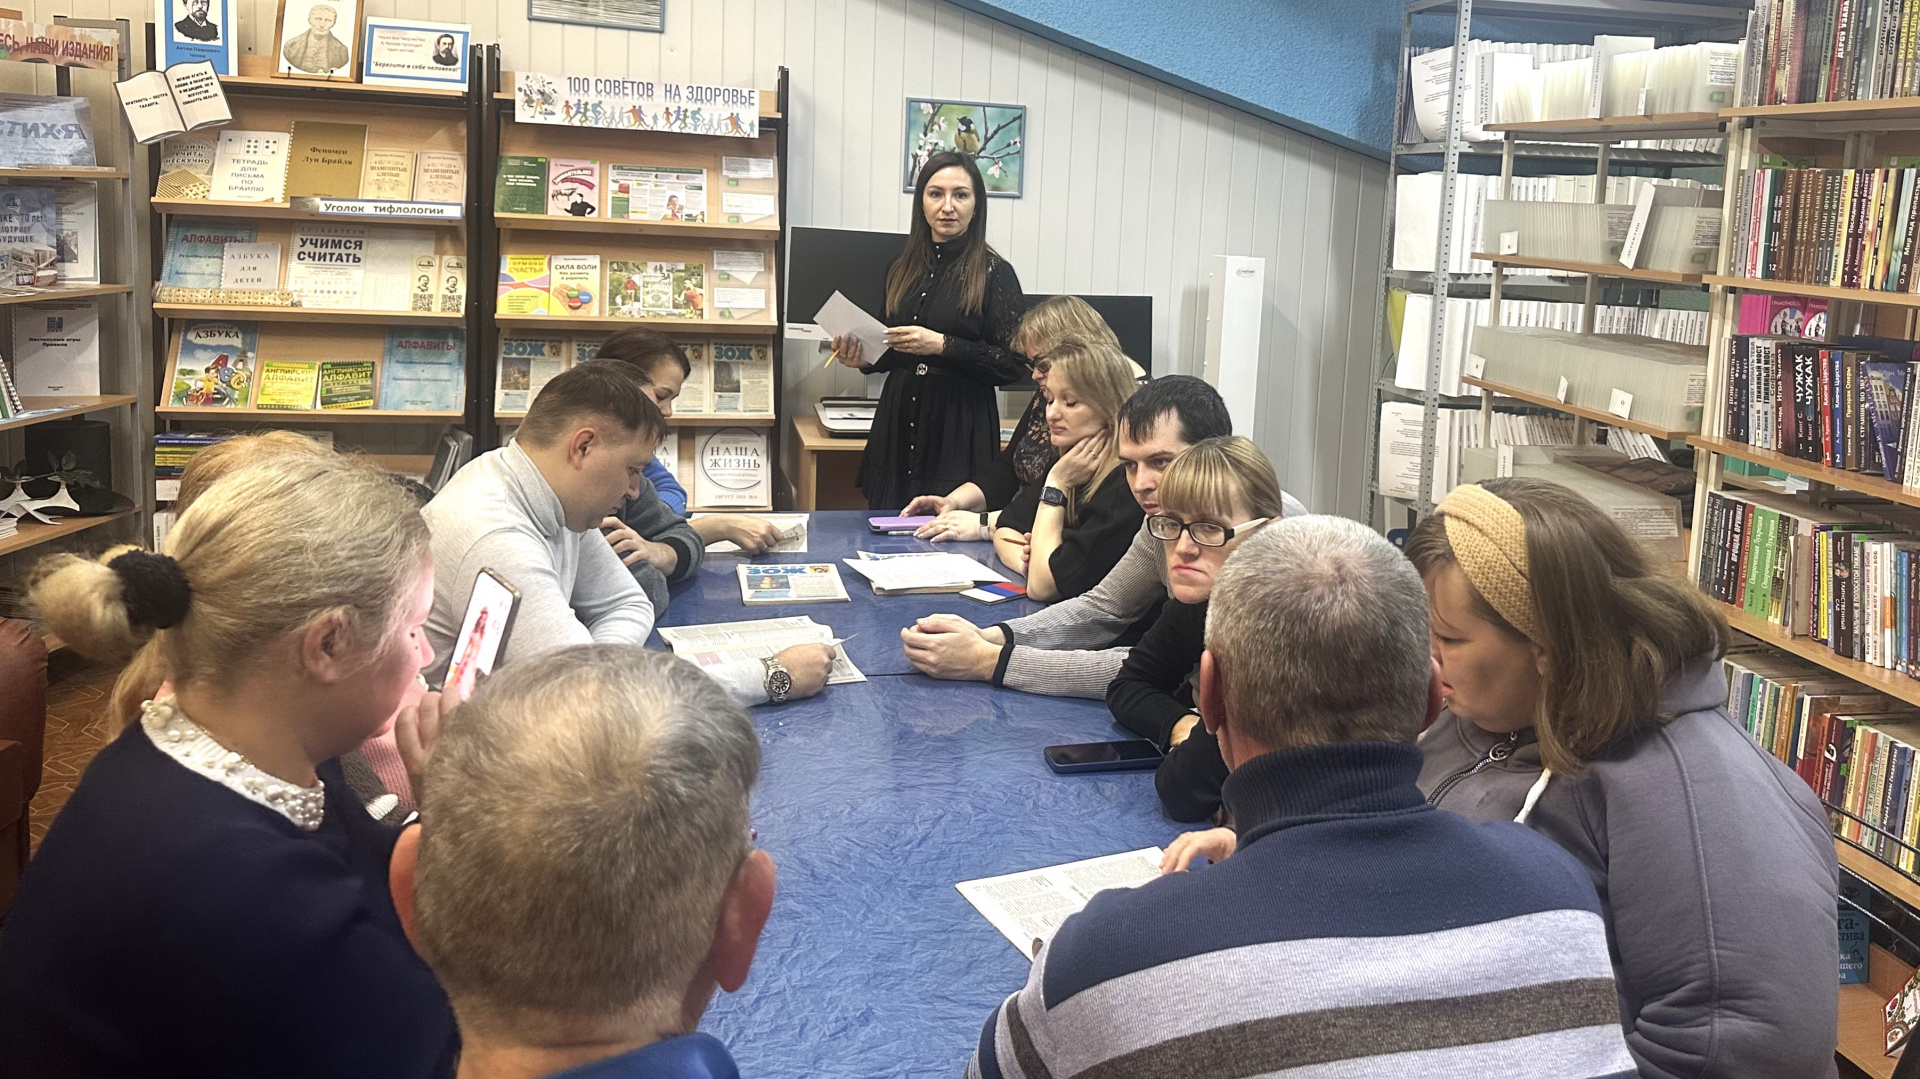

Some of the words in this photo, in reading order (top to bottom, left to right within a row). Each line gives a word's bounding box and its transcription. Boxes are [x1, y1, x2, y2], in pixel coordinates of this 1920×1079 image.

[1840, 0, 1850, 28] УЗАЛА
[1837, 30, 1846, 58] ДЕРСУ
[1846, 12, 1855, 52] Шагреневая
[1879, 16, 1888, 56] ВОЛЧЬЯ
[1888, 15, 1898, 56] ВОЛЧЬЯ
[1907, 14, 1918, 59] КУСАТЕЛЬ
[26, 37, 59, 56] НАШИ
[62, 41, 114, 63] ИЗДАНИЯ!
[1894, 67, 1902, 88] Веркин
[1898, 14, 1909, 59] КУСАТЕЛЬ
[567, 76, 590, 95] 100
[594, 78, 655, 98] СОВЕТОВ
[665, 83, 682, 100] НА
[686, 85, 756, 106] ЗДОРОВЬЕ
[231, 158, 268, 166] ТЕТРАДЬ
[302, 156, 320, 164] Луи
[322, 156, 353, 166] Брайля
[310, 146, 348, 155] Феномен
[228, 185, 264, 193] БРАЙЛЮ
[1838, 175, 1848, 218] НАМЕРЕНИЯ
[1910, 177, 1920, 220] пропастью
[324, 202, 365, 213] Уголок
[373, 203, 444, 215] тифлологии
[1733, 207, 1741, 232] Сандро
[1782, 194, 1791, 241] АФРИКАНСКИЙ
[1796, 194, 1805, 241] АФРИКАНСКИЙ
[1802, 194, 1811, 241] АФРИКАНСКИЙ
[1812, 195, 1821, 242] АФРИКАНСКИЙ
[1820, 210, 1828, 242] ТАЙНЫЕ
[1824, 175, 1832, 210] ФРЕГАТЫ
[1828, 210, 1836, 242] ТАЙНЫЕ
[1832, 175, 1841, 210] ФРЕГАТЫ
[1848, 198, 1857, 234] Последний
[1857, 198, 1866, 234] Последний
[181, 234, 244, 245] АЛФАВИТЫ
[1835, 221, 1843, 248] БЛАГИЕ
[1907, 221, 1915, 236] над
[229, 252, 270, 260] АЗБУКА
[299, 237, 364, 251] УЧИМСЯ
[1903, 238, 1912, 256] Мир
[297, 251, 362, 264] СЧИТАТЬ
[1900, 263, 1908, 276] Рой
[194, 330, 240, 340] АЗБУКА
[396, 340, 456, 350] АЛФАВИТЫ
[503, 342, 546, 356] ЗОЖ
[714, 346, 753, 361] ЗОЖ
[263, 374, 315, 383] АЛФАВИТ
[265, 368, 316, 376] АНГЛИЙСКИЙ
[322, 371, 372, 382] АЛФАВИТ
[323, 366, 373, 376] АНГЛИЙСКИЙ
[1795, 354, 1804, 403] ЧУЖАК
[1805, 356, 1814, 405] ЧУЖАК
[1821, 358, 1829, 383] Царства
[1833, 360, 1841, 386] Царства
[1845, 366, 1853, 389] Оперы
[1754, 365, 1762, 403] ГЛИНЯНЫЙ
[1762, 367, 1770, 404] ГЛИНЯНЫЙ
[1863, 375, 1879, 429] АМСТЕРДАМ
[1900, 390, 1909, 428] царствования
[709, 459, 760, 469] ЖИЗНЬ
[710, 446, 760, 457] НАША
[1835, 453, 1841, 463] 2
[1733, 504, 1743, 533] ОРУЖИЕ!
[1753, 516, 1764, 545] Лукреция
[1764, 519, 1776, 548] Лукреция
[1748, 546, 1760, 585] Опороченная
[1760, 549, 1772, 589] Опороченная
[1818, 725, 1827, 749] Греции
[1814, 749, 1823, 774] Древней
[1912, 759, 1920, 774] дома
[1847, 757, 1857, 794] Неуклюжая
[1886, 782, 1894, 806] страны
